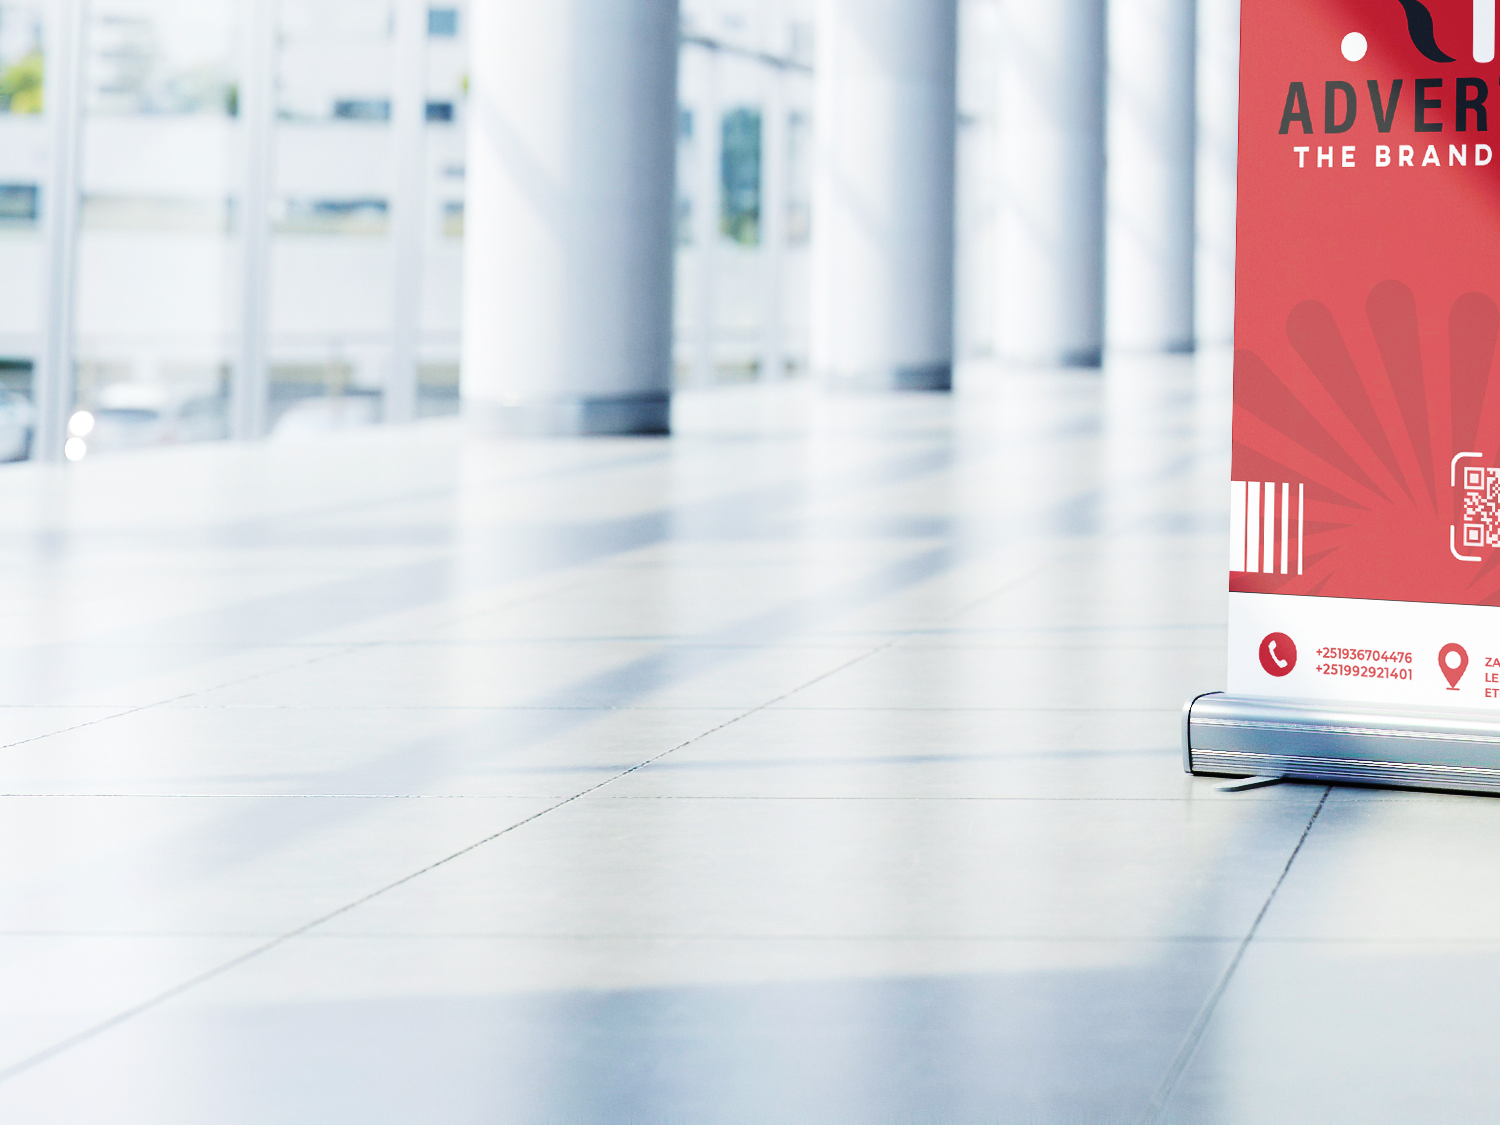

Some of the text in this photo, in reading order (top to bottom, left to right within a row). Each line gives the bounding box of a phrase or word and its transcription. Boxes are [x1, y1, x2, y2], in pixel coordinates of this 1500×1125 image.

[1293, 145, 1356, 168] THE
[1315, 646, 1413, 664] +251936704476
[1315, 663, 1413, 681] +251992921401
